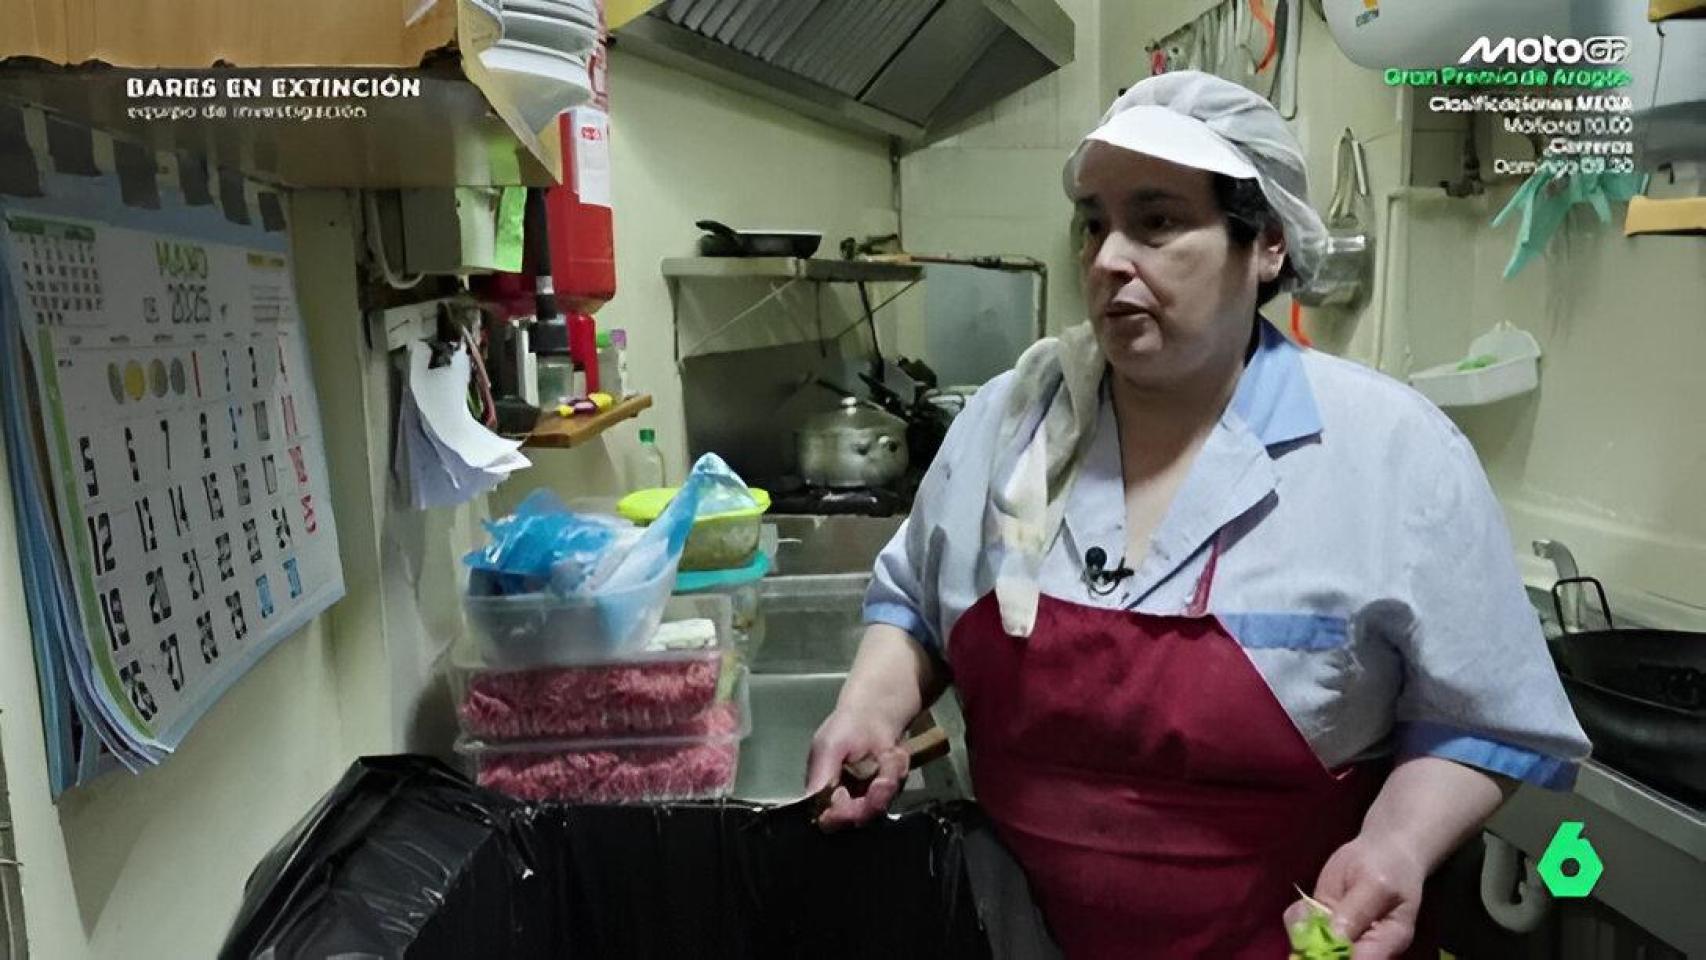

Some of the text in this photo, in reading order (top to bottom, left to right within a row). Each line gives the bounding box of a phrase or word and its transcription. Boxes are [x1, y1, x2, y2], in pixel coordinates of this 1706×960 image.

[79, 436, 99, 497] 5
[160, 419, 171, 470] 7
[88, 513, 116, 576] 12
